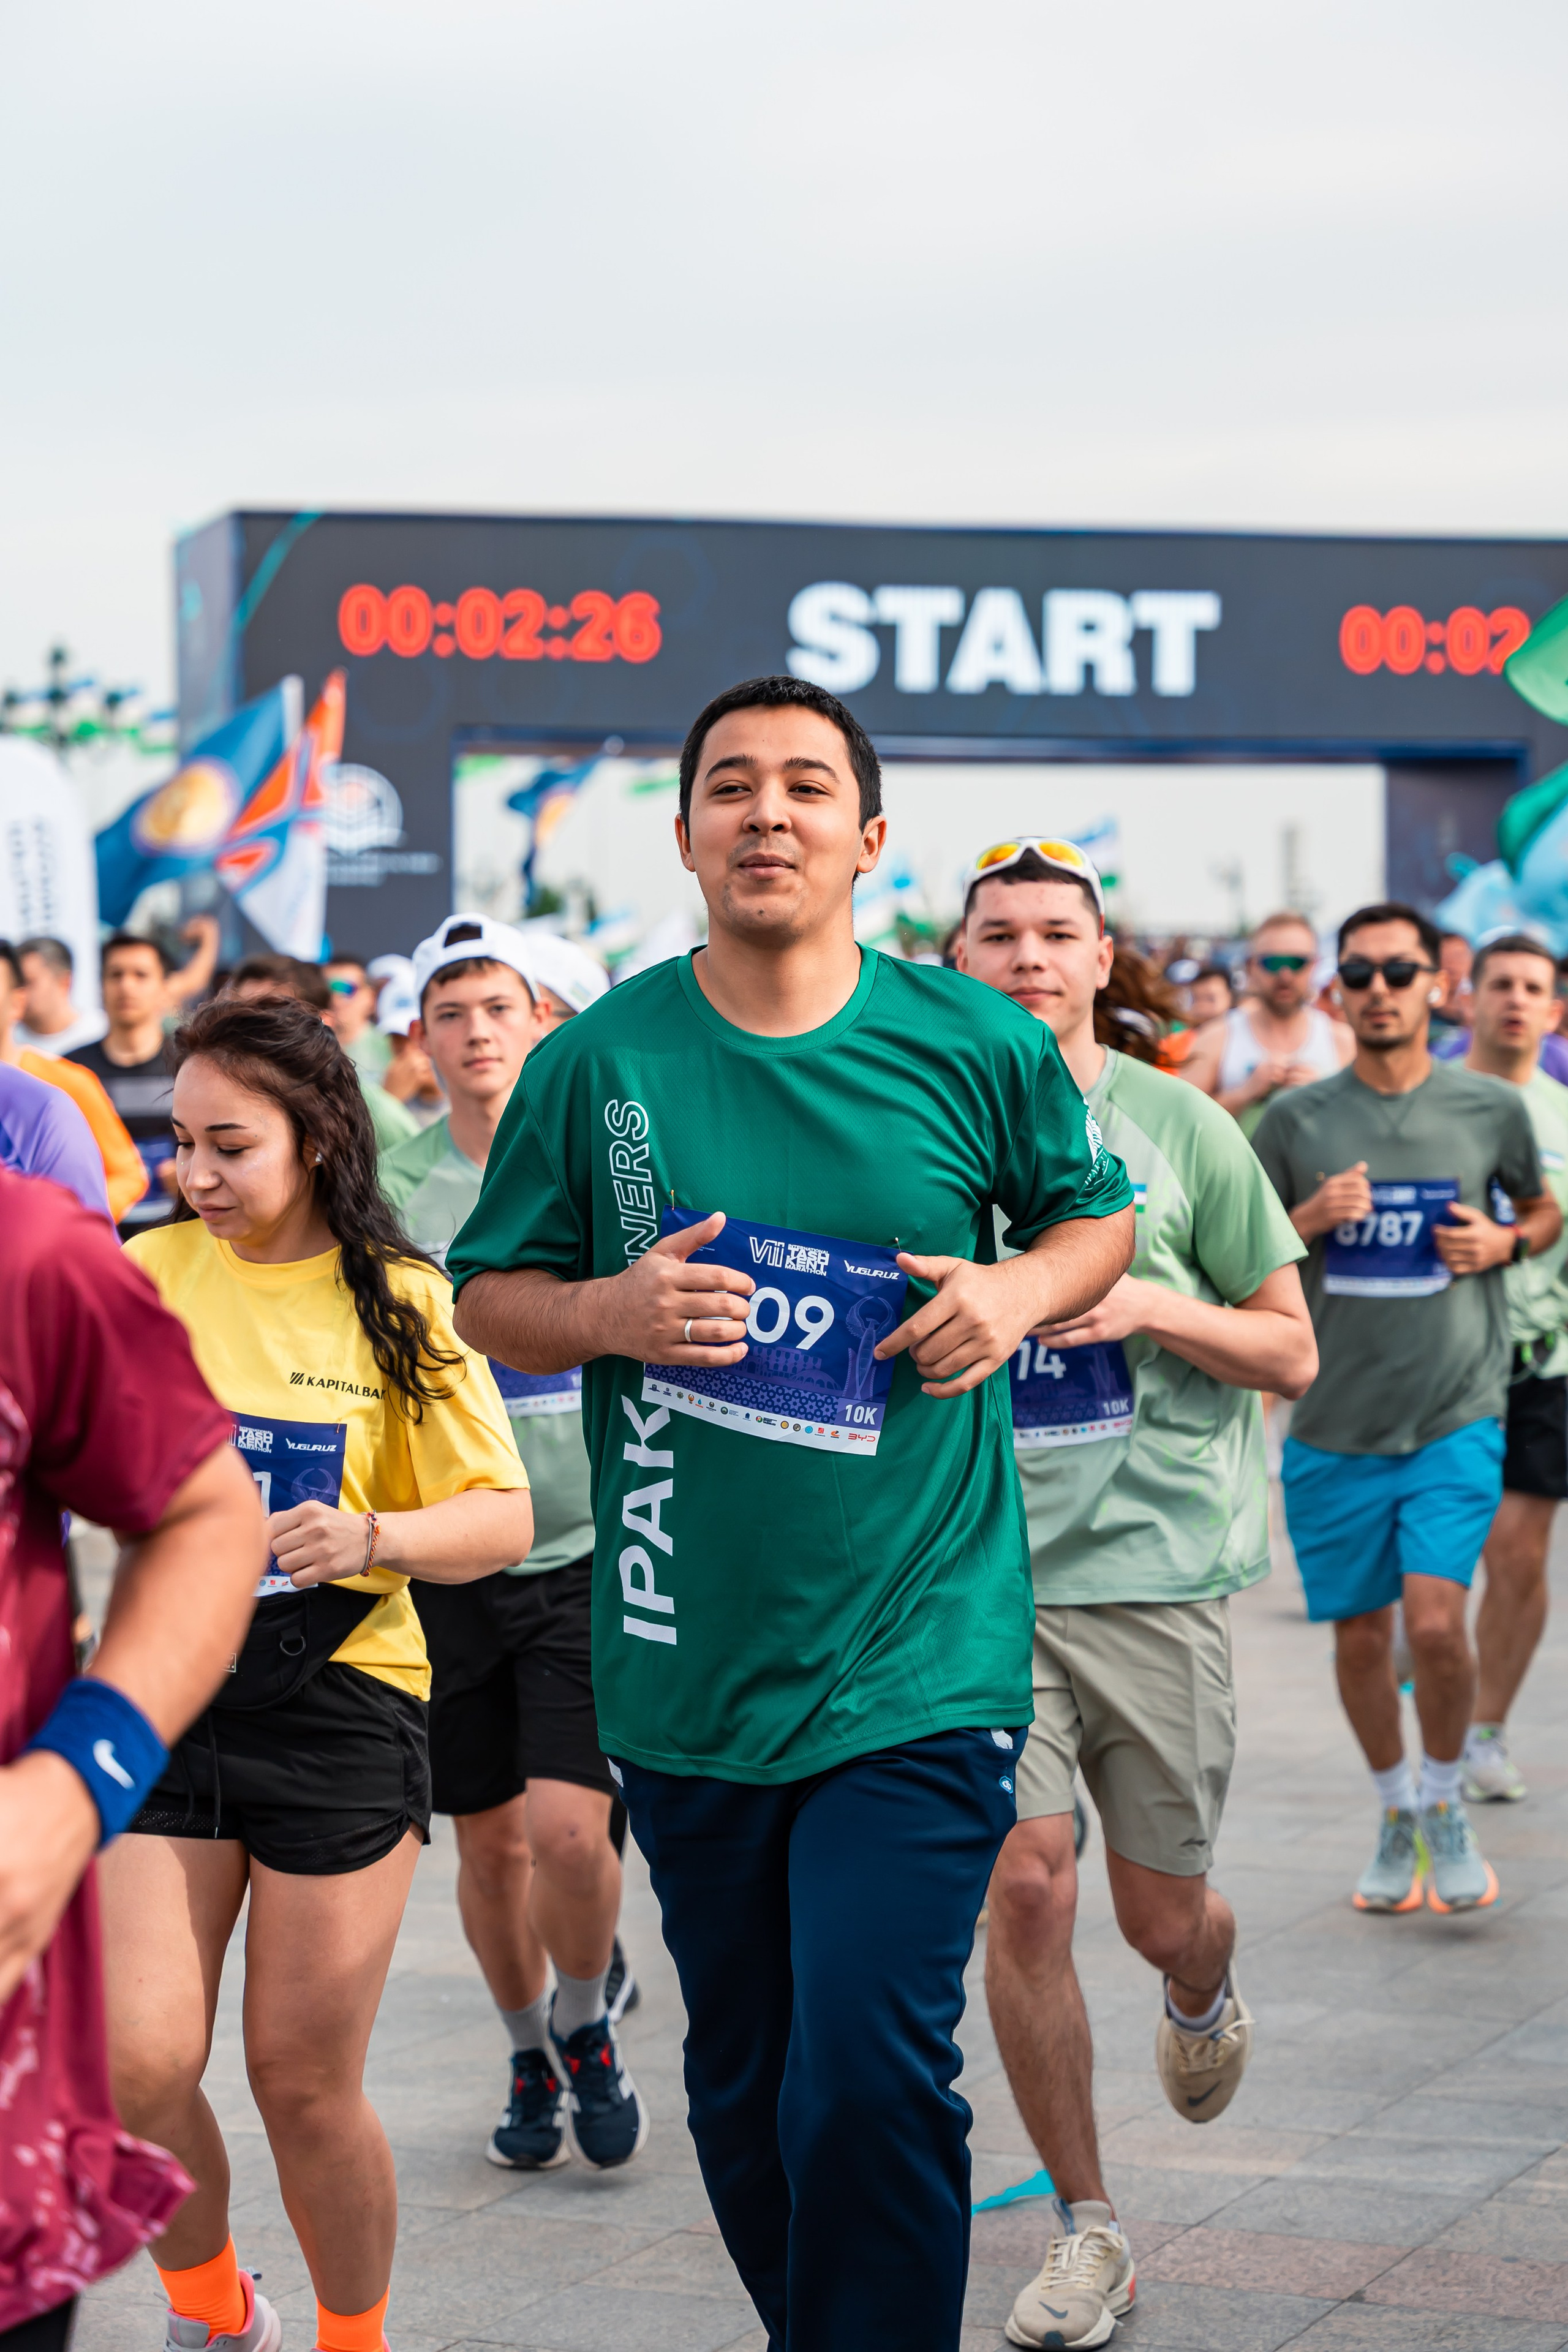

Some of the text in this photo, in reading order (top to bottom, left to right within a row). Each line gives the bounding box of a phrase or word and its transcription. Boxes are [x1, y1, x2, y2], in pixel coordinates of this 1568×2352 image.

[338, 584, 662, 664] 00:02:26
[786, 581, 1222, 697] START
[788, 1243, 829, 1255] INTERNATIONAL
[788, 1246, 829, 1266] TASH
[785, 1263, 827, 1276] MARATHON
[786, 1255, 828, 1272] KENT
[605, 1099, 677, 1646] IPAK NERS
[845, 1404, 878, 1425] 10K
[1103, 1398, 1129, 1416] 10K
[238, 1436, 272, 1451] KENT
[239, 1428, 273, 1445] TASH
[848, 1433, 876, 1442] BYD
